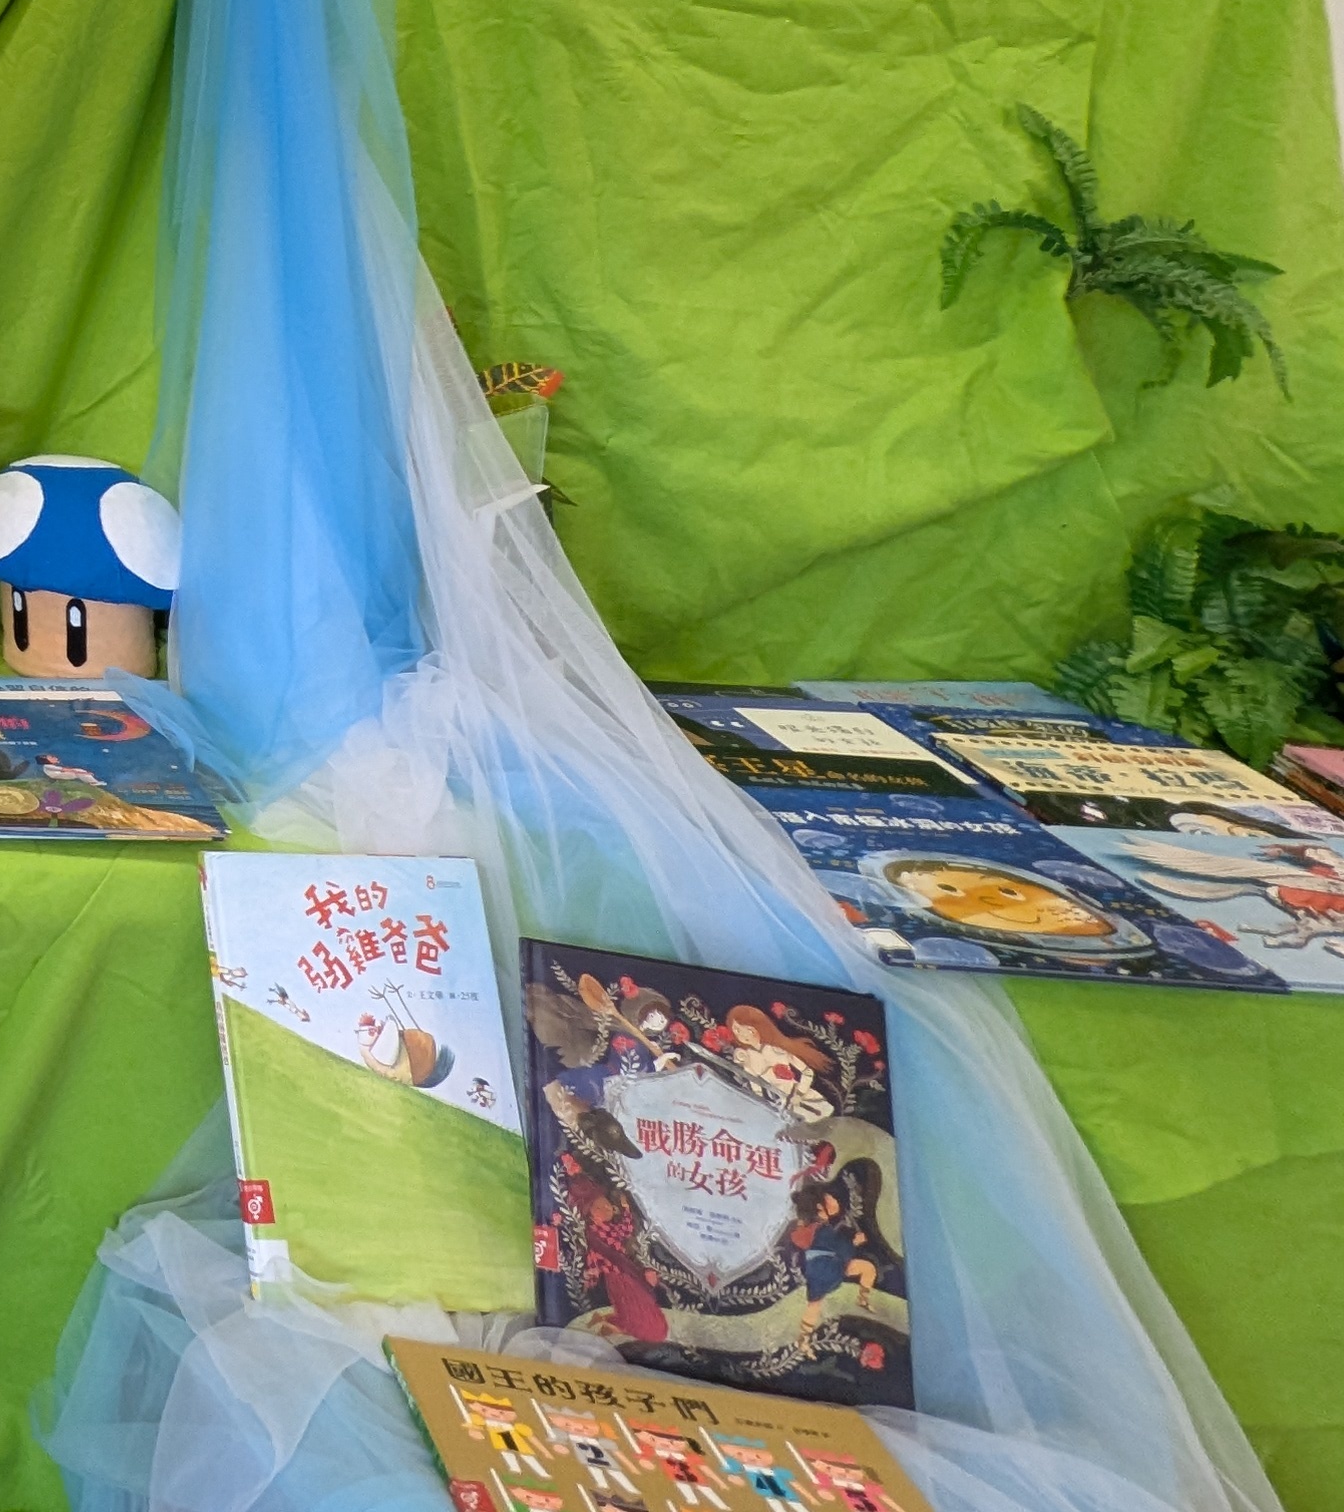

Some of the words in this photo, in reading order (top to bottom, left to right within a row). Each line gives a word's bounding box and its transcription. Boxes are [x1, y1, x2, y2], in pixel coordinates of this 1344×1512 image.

[305, 881, 388, 929] 我的
[297, 914, 450, 993] 弱雞爸爸
[636, 1116, 782, 1180] 戰勝命運
[667, 1161, 748, 1201] 的女孩
[441, 1358, 720, 1425] 國王的孩子們
[576, 1441, 611, 1467] 2
